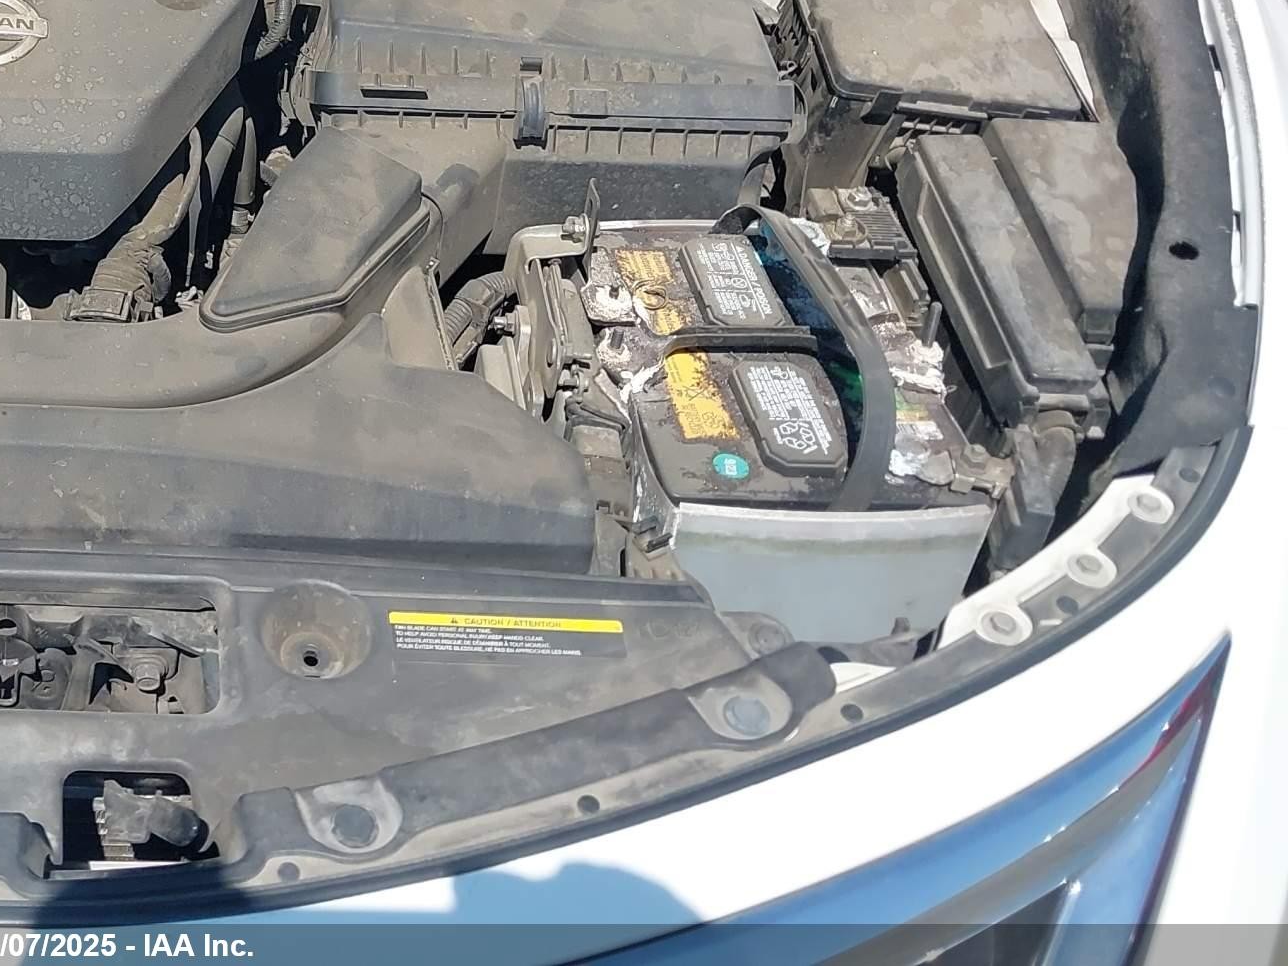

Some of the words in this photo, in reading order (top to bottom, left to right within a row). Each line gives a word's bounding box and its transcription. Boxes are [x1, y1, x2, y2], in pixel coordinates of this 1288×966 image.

[739, 253, 758, 281] DANGER
[754, 287, 773, 314] POISON
[464, 618, 504, 627] CAUTION
[513, 619, 561, 628] ATTENTION
